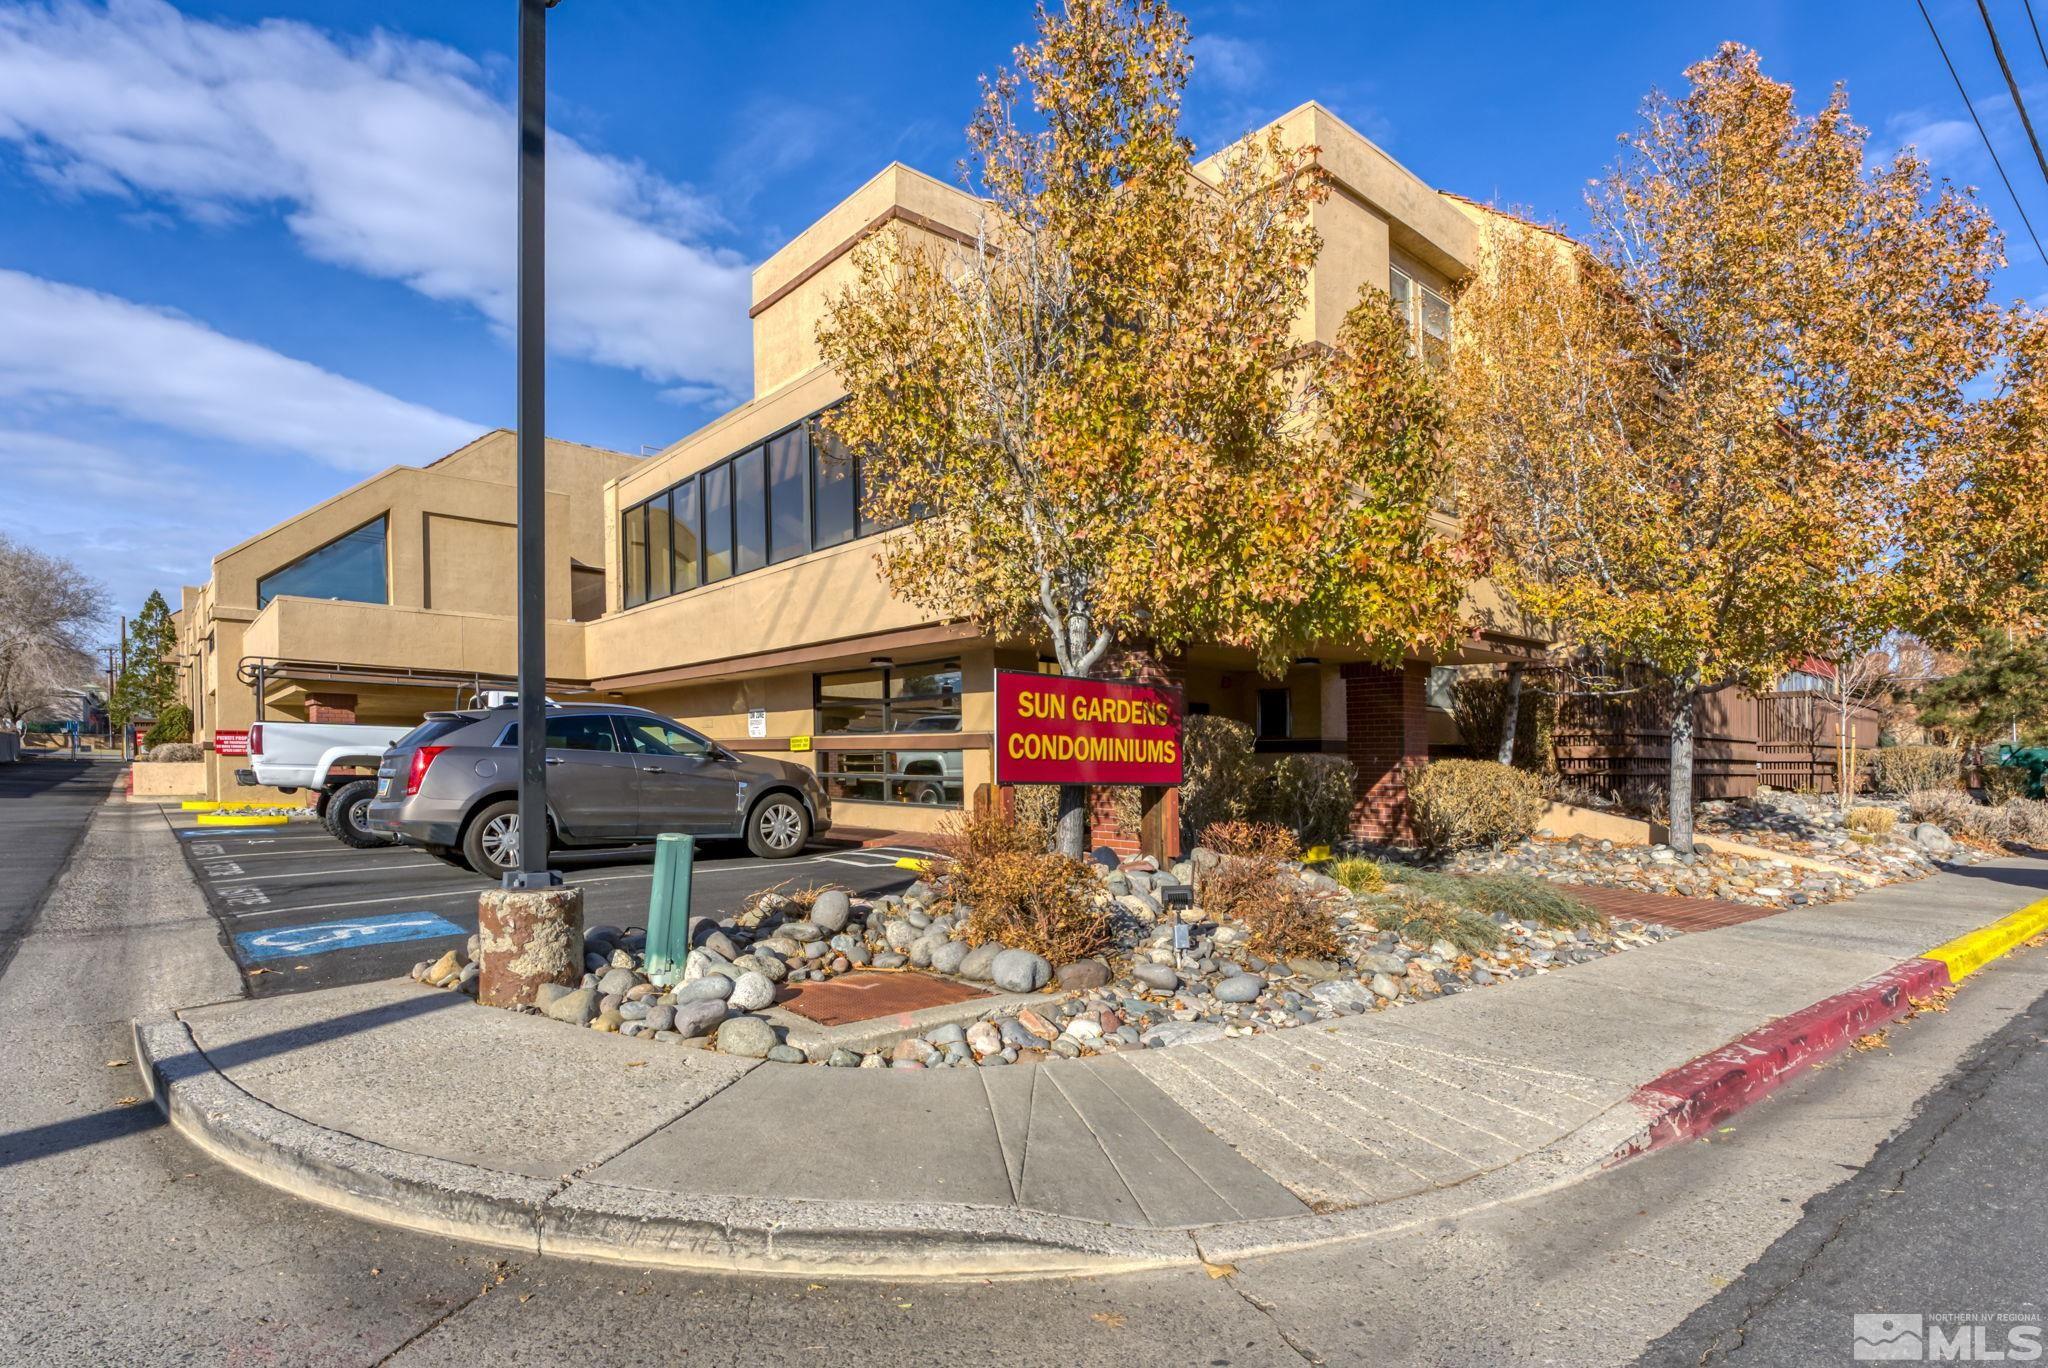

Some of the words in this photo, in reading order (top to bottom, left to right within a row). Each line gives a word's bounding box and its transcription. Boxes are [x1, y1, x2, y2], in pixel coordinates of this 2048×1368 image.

[1018, 691, 1066, 720] SUN
[1072, 696, 1168, 726] GARDENS
[1008, 733, 1176, 764] CONDOMINIUMS
